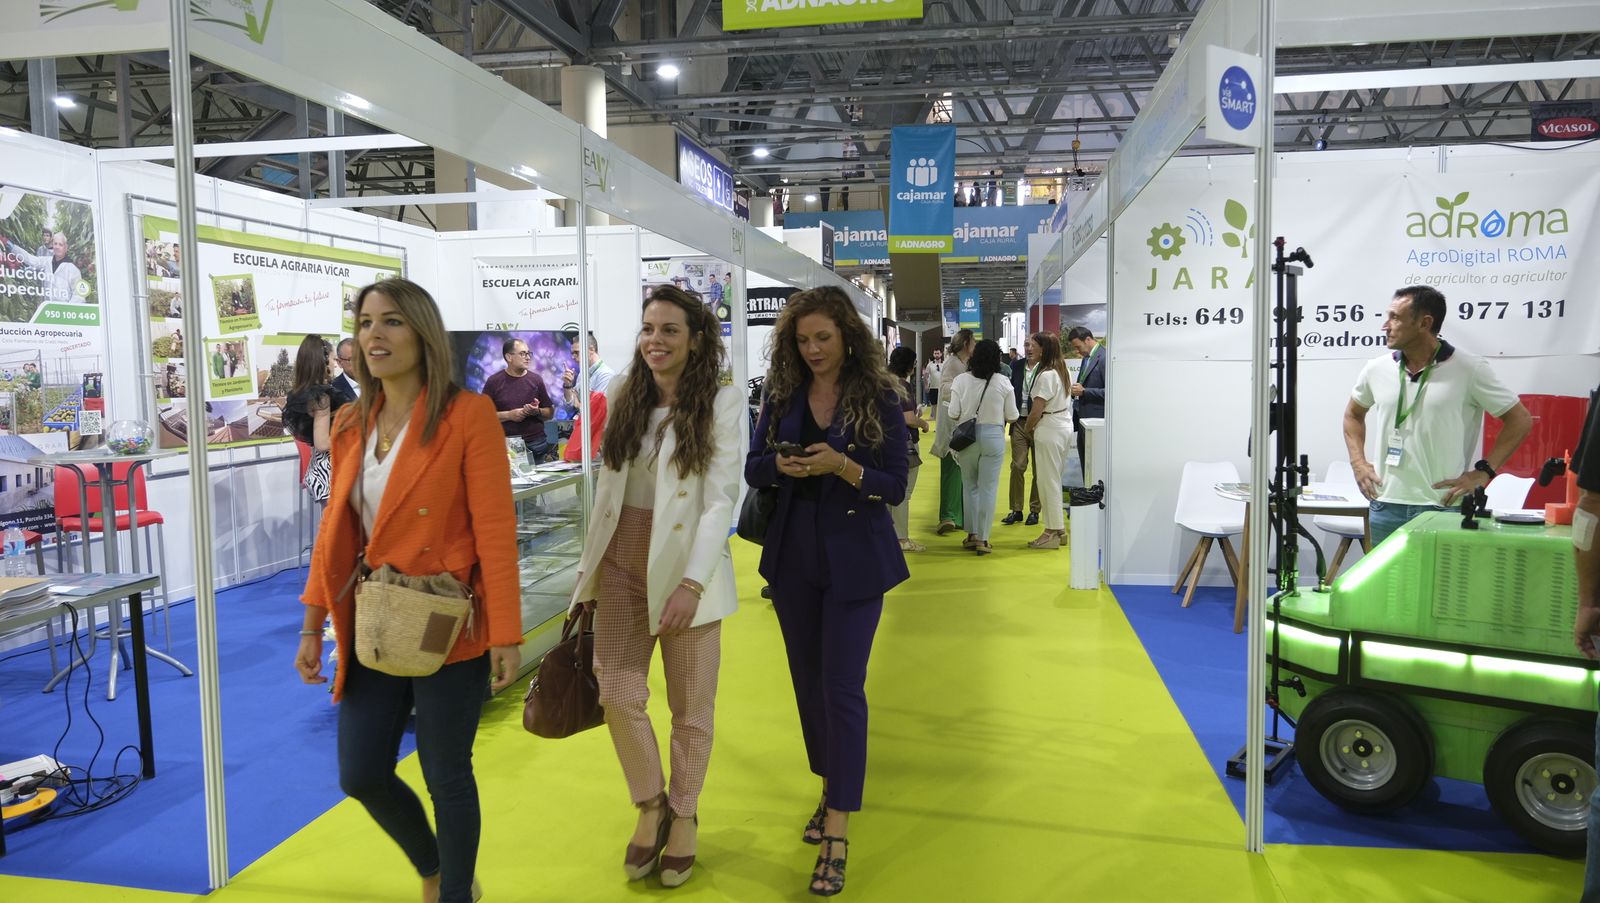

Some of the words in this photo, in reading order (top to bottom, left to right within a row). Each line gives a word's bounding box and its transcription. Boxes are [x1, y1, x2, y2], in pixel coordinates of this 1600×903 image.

[1221, 97, 1254, 114] SMART
[1541, 123, 1596, 134] VICASOL
[897, 189, 946, 204] cajamar
[900, 240, 946, 249] ADNAGRO
[996, 238, 1016, 246] RURAL
[1406, 249, 1501, 267] AgroDigital
[1508, 244, 1568, 262] ROMA
[233, 252, 279, 269] ESCUELA
[281, 259, 323, 274] AGRARIA
[324, 263, 350, 278] VÍCAR
[482, 278, 531, 288] ESCUELA
[1405, 273, 1421, 285] de
[1427, 271, 1486, 286] agricultor
[1491, 274, 1499, 284] a
[1503, 271, 1568, 286] agricultor
[516, 289, 552, 300] VÍCAR
[45, 310, 60, 319] 950
[62, 311, 76, 319] 100
[78, 312, 96, 320] 440
[1144, 312, 1188, 326] Tels:
[1195, 306, 1244, 325] 649
[1315, 304, 1364, 323] 556
[1458, 301, 1510, 320] 977
[1522, 299, 1566, 319] 131
[35, 329, 82, 338] Agropecuaria
